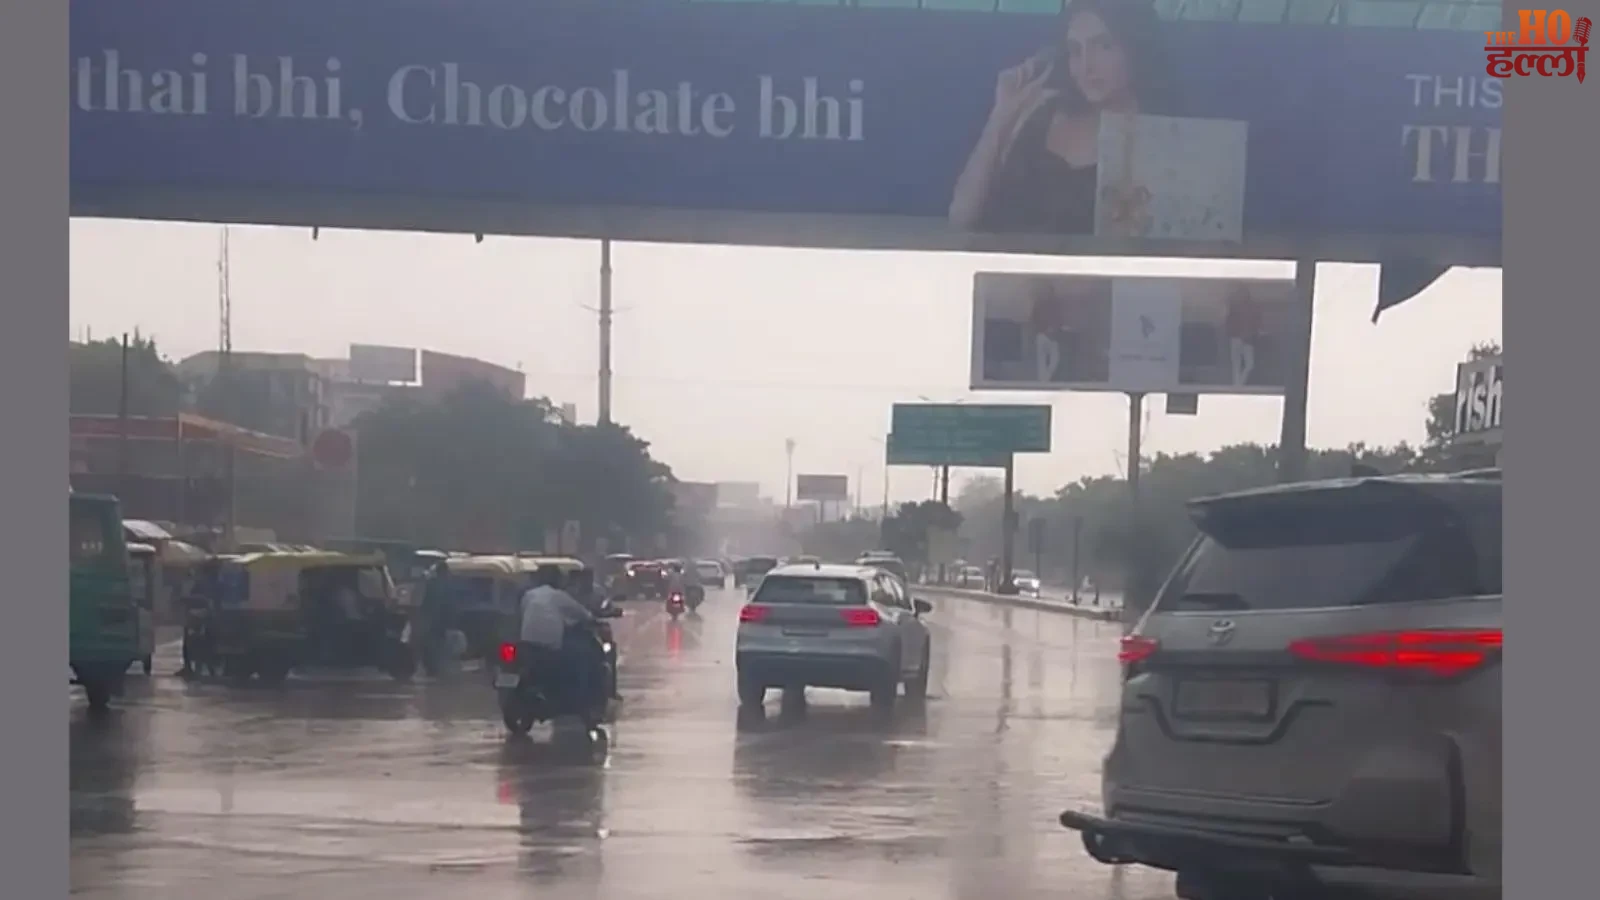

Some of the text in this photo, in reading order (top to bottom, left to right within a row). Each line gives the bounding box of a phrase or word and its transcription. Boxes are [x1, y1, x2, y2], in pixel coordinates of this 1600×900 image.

[75, 49, 865, 141] thai bhi, Chocolate bhi
[1405, 73, 1502, 108] THIS
[1455, 364, 1502, 434] rish
